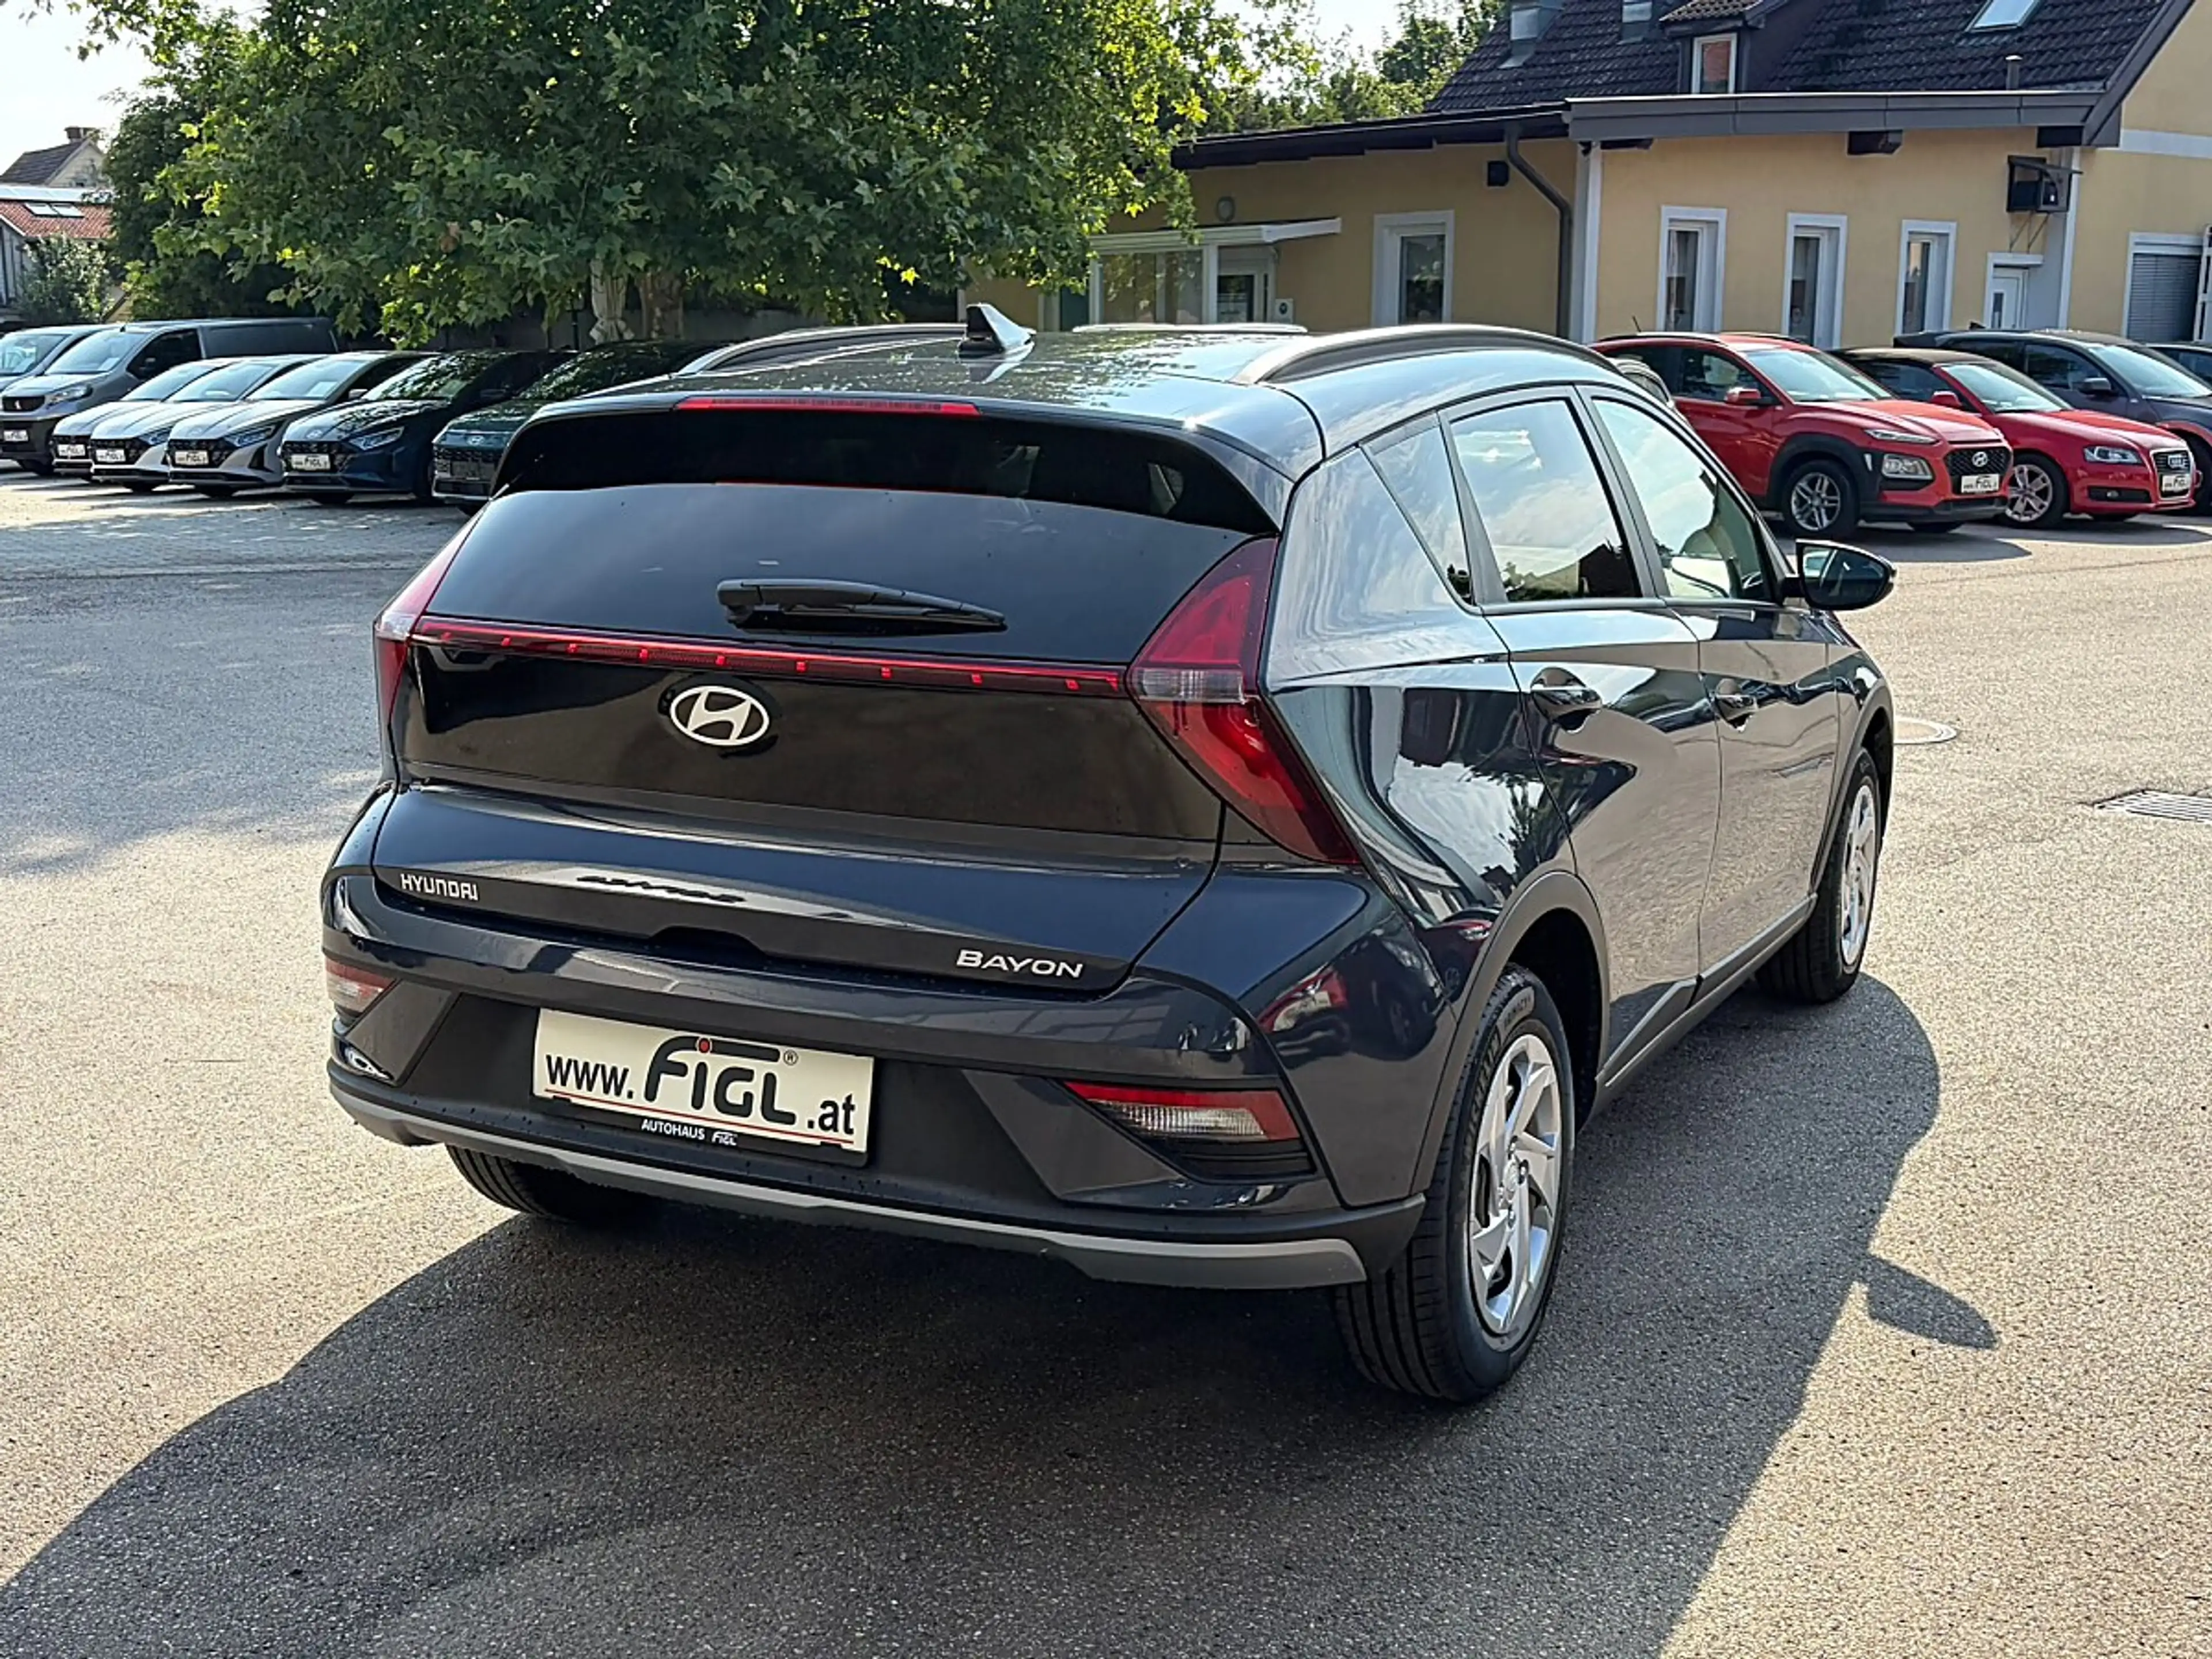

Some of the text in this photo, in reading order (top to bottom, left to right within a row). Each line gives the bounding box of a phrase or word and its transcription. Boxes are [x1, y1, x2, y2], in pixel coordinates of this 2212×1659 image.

[400, 873, 478, 901] HYUNDAI
[956, 949, 1083, 978] BAYON
[641, 1119, 705, 1140] AUTOHAUS
